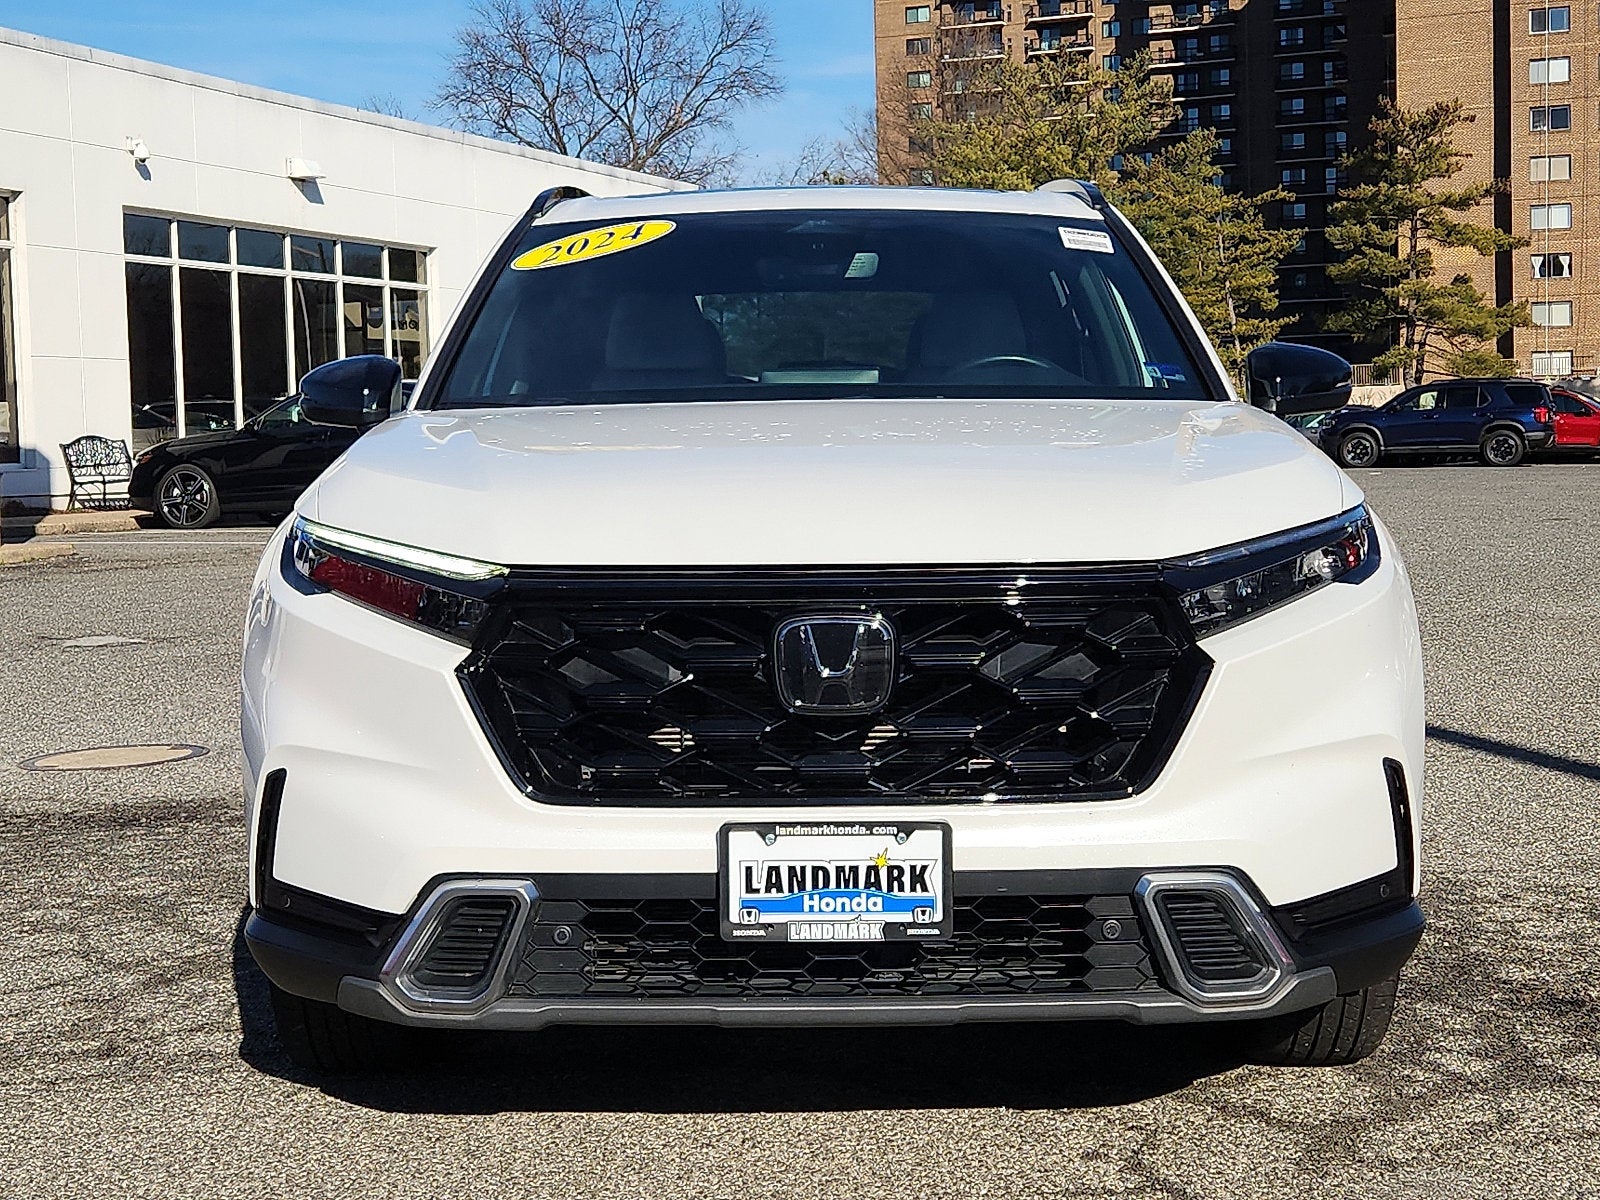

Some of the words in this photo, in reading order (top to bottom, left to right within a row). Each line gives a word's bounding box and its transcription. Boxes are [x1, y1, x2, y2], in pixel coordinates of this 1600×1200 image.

[538, 223, 646, 265] 2024
[745, 865, 930, 894] LANDMARK
[803, 893, 883, 913] Honda
[790, 922, 882, 940] LANDMARK
